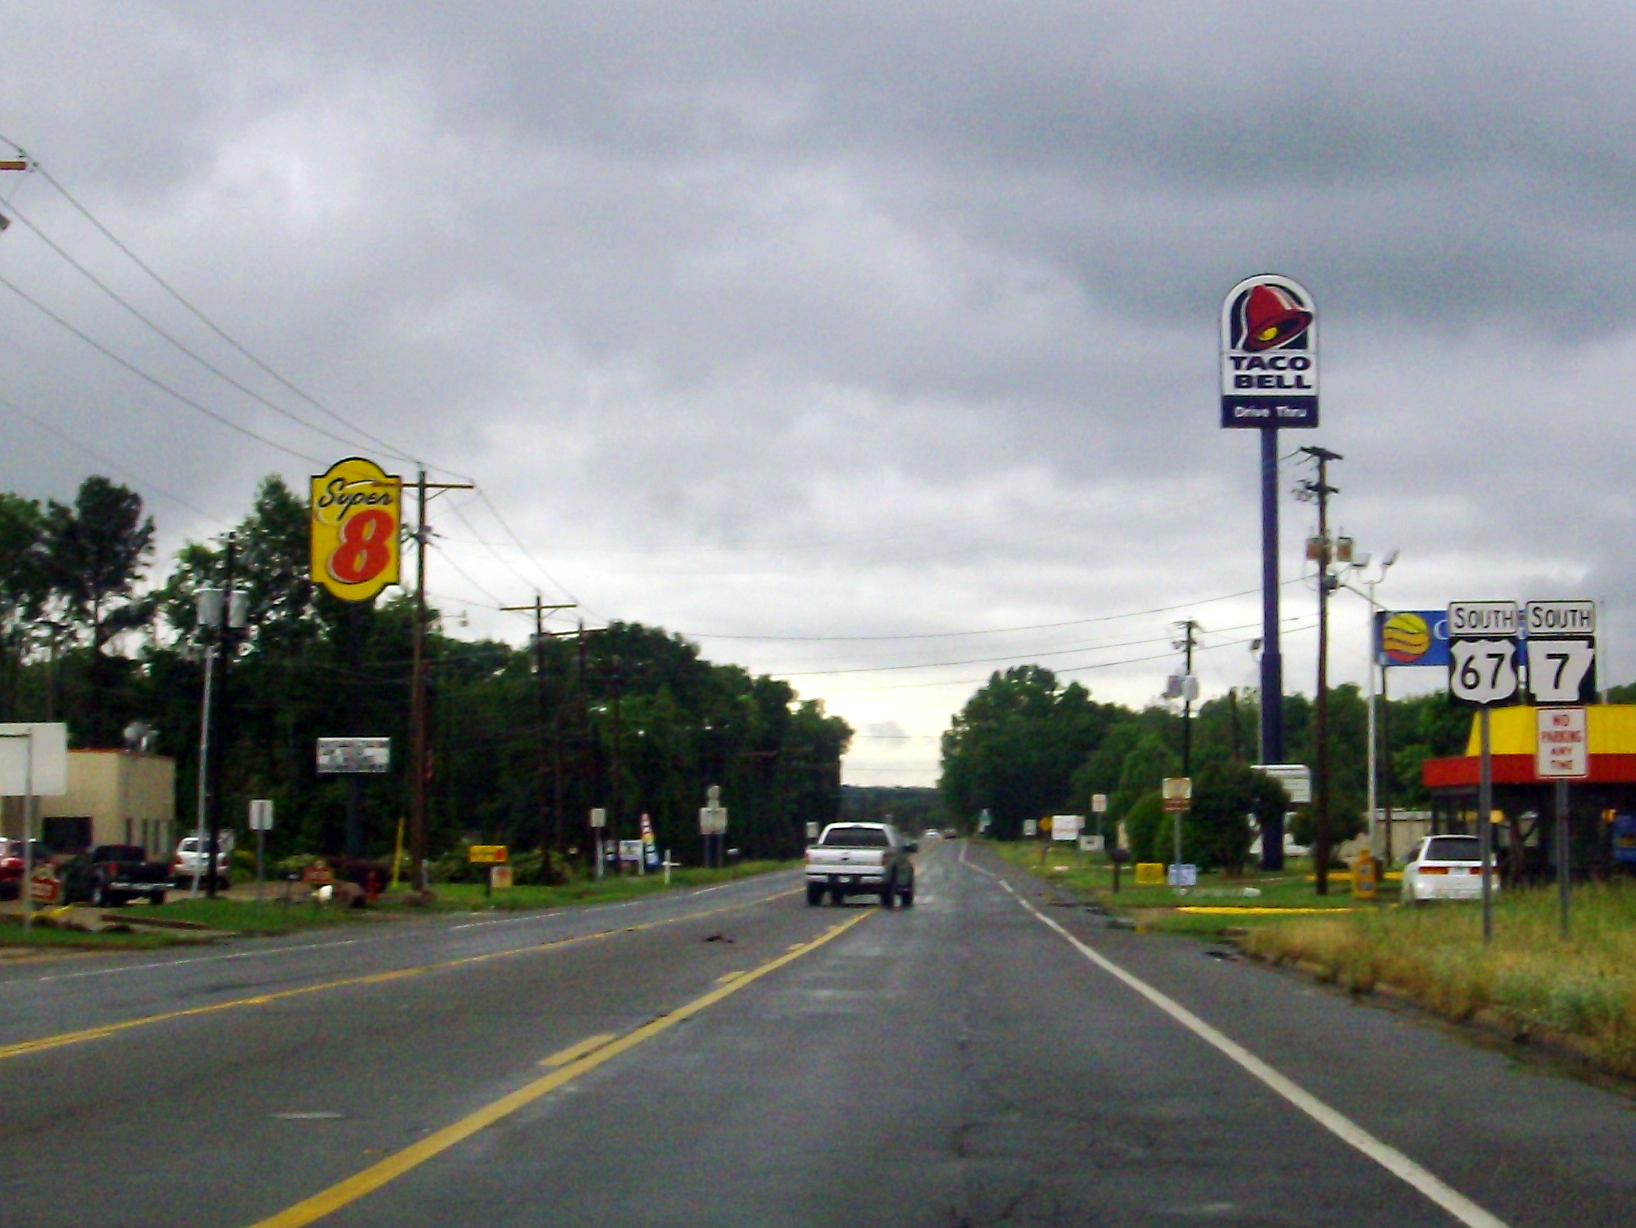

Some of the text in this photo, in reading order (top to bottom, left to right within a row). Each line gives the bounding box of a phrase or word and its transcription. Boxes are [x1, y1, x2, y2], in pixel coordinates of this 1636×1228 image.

[1229, 356, 1311, 371] TACO
[1234, 375, 1312, 389] BELL
[318, 478, 393, 521] Super
[329, 509, 395, 583] 8
[1454, 607, 1514, 629] SOUTH
[1532, 606, 1590, 629] SOUTH
[1461, 653, 1506, 690] 67
[1545, 653, 1570, 690] 7
[1553, 714, 1570, 727] NO
[1541, 730, 1581, 744] PARKING
